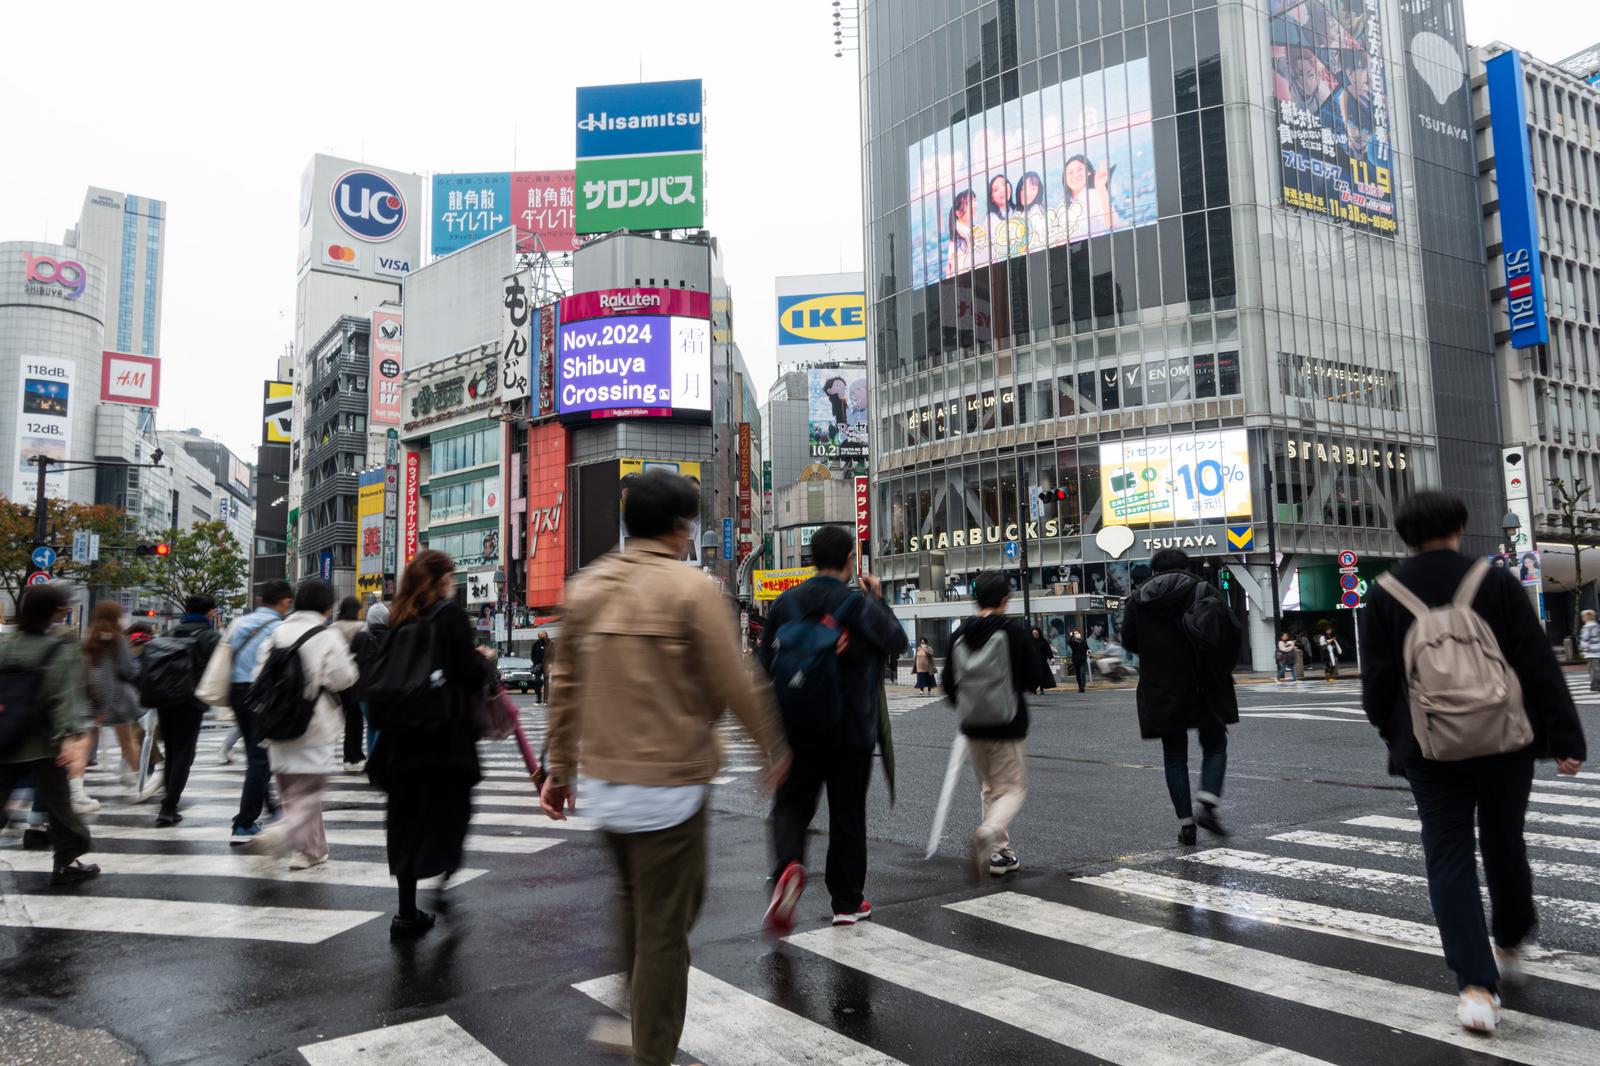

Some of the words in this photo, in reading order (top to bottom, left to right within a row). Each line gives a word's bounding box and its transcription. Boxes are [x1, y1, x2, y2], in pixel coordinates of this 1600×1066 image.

[577, 111, 701, 132] Hisamitsu
[1418, 114, 1469, 142] TSUTAYA
[340, 182, 399, 225] UC
[448, 189, 495, 211] 龍角散
[527, 186, 574, 208] 龍角散
[583, 175, 696, 210] サロンパス
[441, 209, 503, 232] ダイレクト
[20, 252, 87, 300] 109
[379, 257, 410, 273] VISA
[24, 283, 63, 299] SHIBUYA
[599, 291, 661, 309] Rakuten
[1505, 247, 1536, 332] SEIBU
[791, 306, 863, 329] IKE
[503, 276, 528, 395] もんじゃ
[563, 323, 652, 352] Nov.2024
[563, 356, 645, 379] Shibuya
[679, 327, 705, 399] 霜月
[116, 369, 146, 388] H&M
[562, 379, 657, 405] Crossing
[1287, 439, 1406, 471] STARBUCKS
[1177, 458, 1244, 500] 10%
[407, 467, 417, 554] ウィンターフルーツギフト
[856, 482, 868, 534] カラオケ
[363, 526, 381, 557] 薬
[909, 520, 1059, 552] STARBUCKS
[1143, 534, 1217, 550] TSUTAYA
